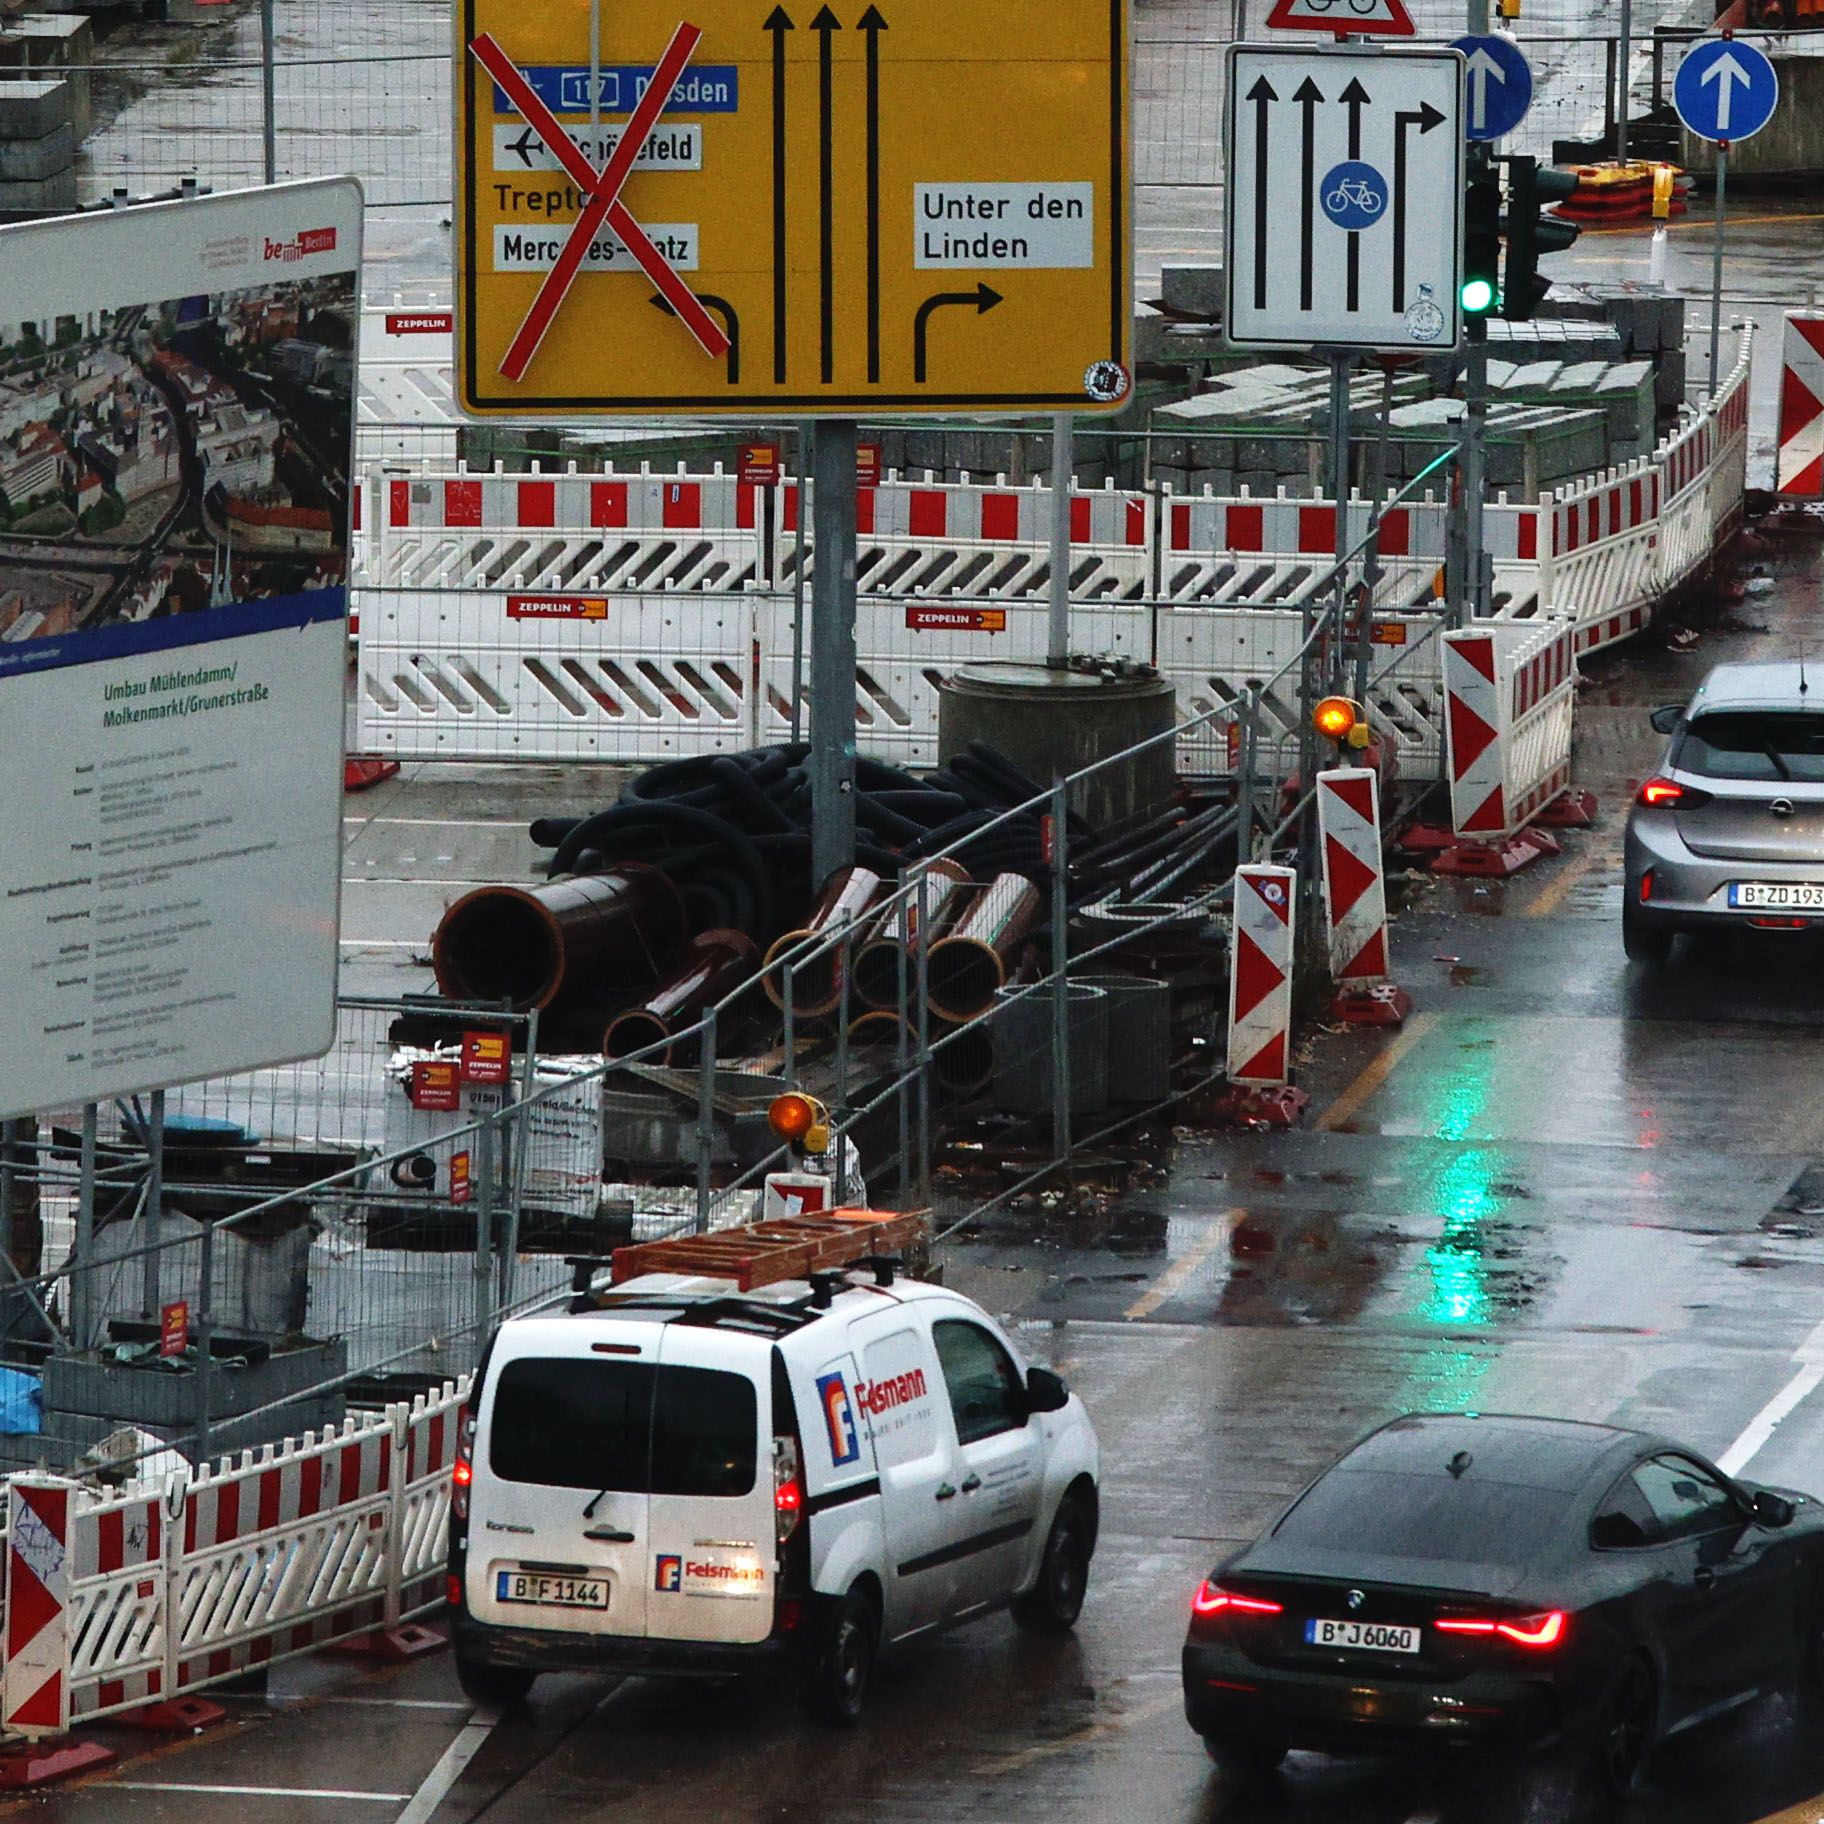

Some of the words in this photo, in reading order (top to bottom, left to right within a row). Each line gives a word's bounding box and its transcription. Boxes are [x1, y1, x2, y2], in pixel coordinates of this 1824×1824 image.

[634, 75, 729, 104] Dsden
[922, 192, 1011, 220] Unter
[1027, 192, 1084, 220] den
[922, 232, 1029, 259] Linden
[396, 319, 446, 329] ZEPPELIN
[517, 602, 571, 613] ZEPPELIN
[917, 613, 971, 625] ZEPPELIN
[102, 679, 146, 702] Umbau
[1744, 888, 1756, 906] B
[1791, 888, 1824, 906] 193
[853, 1368, 928, 1421] Felsmann
[515, 1577, 527, 1597] B
[1322, 1622, 1336, 1642] B
